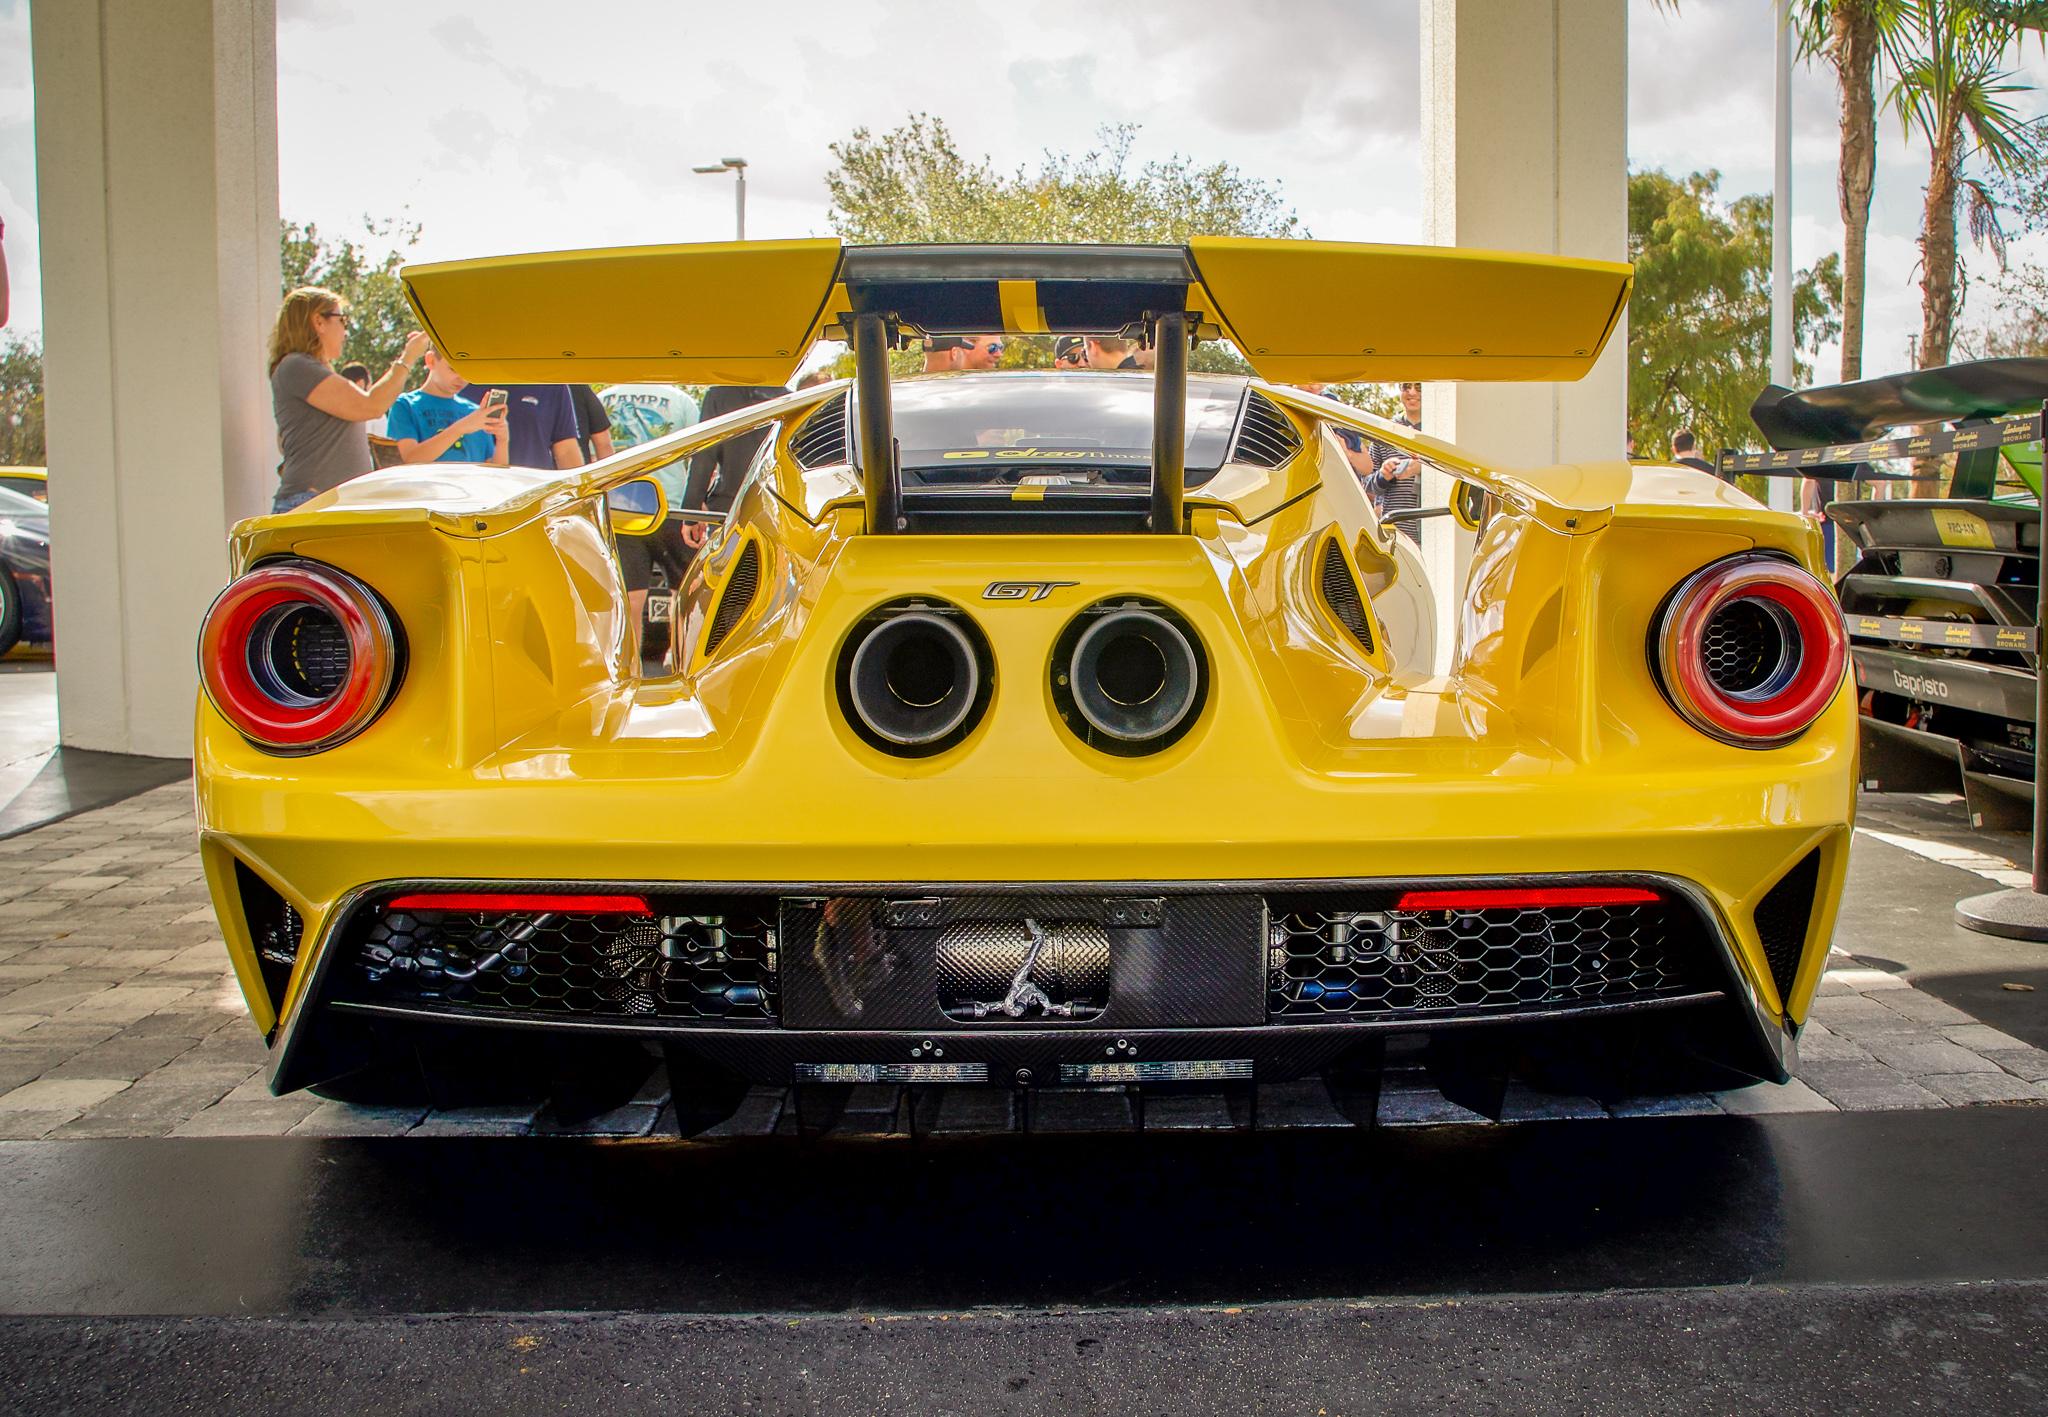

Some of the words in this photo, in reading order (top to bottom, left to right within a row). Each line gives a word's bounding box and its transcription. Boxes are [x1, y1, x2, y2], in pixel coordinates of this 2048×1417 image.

[603, 394, 671, 409] TAMPA
[2002, 433, 2032, 444] BROWARD
[982, 581, 1080, 602] GT
[1996, 640, 2026, 649] BROWARD
[1893, 669, 1948, 698] Capristo
